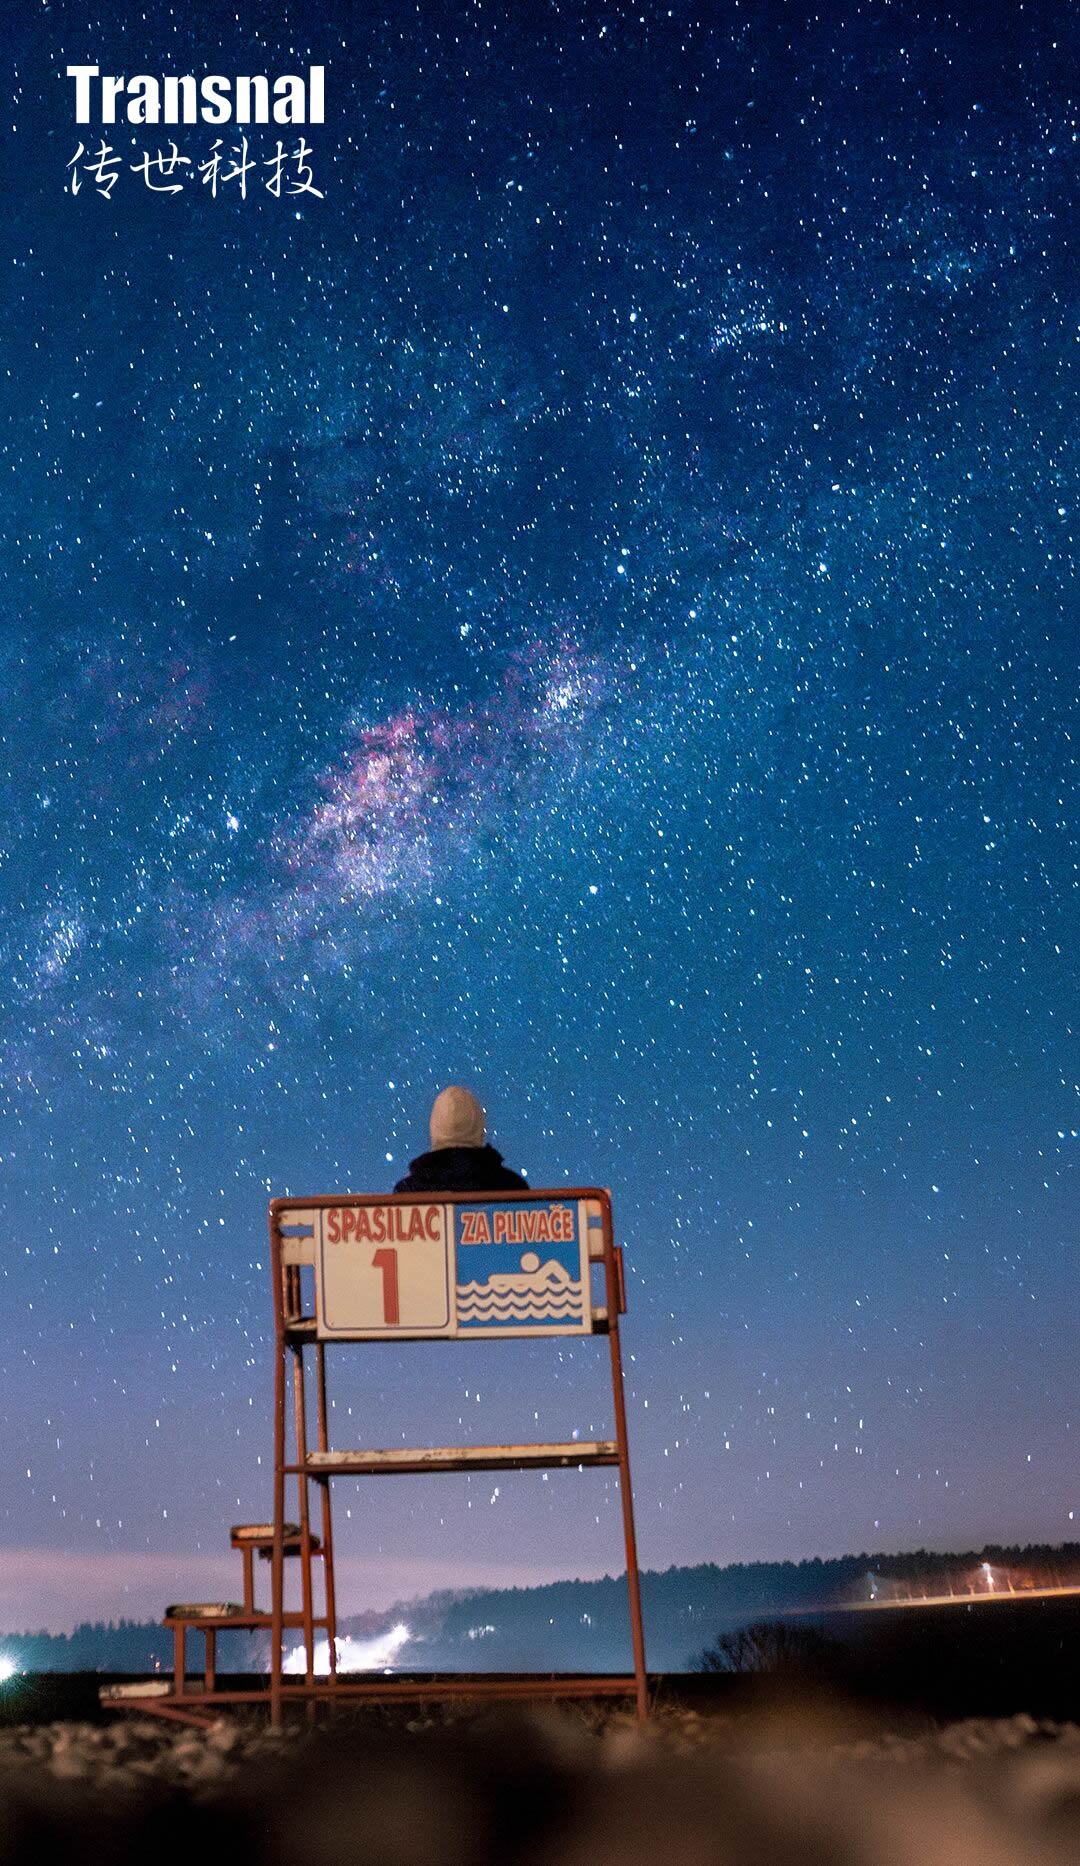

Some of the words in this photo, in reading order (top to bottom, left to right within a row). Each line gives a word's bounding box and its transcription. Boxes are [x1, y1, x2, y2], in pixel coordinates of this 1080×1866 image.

[327, 1206, 441, 1244] SPASILAC
[460, 1211, 491, 1245] ZA
[493, 1204, 575, 1244] PLIVAČE
[371, 1247, 400, 1324] 1
